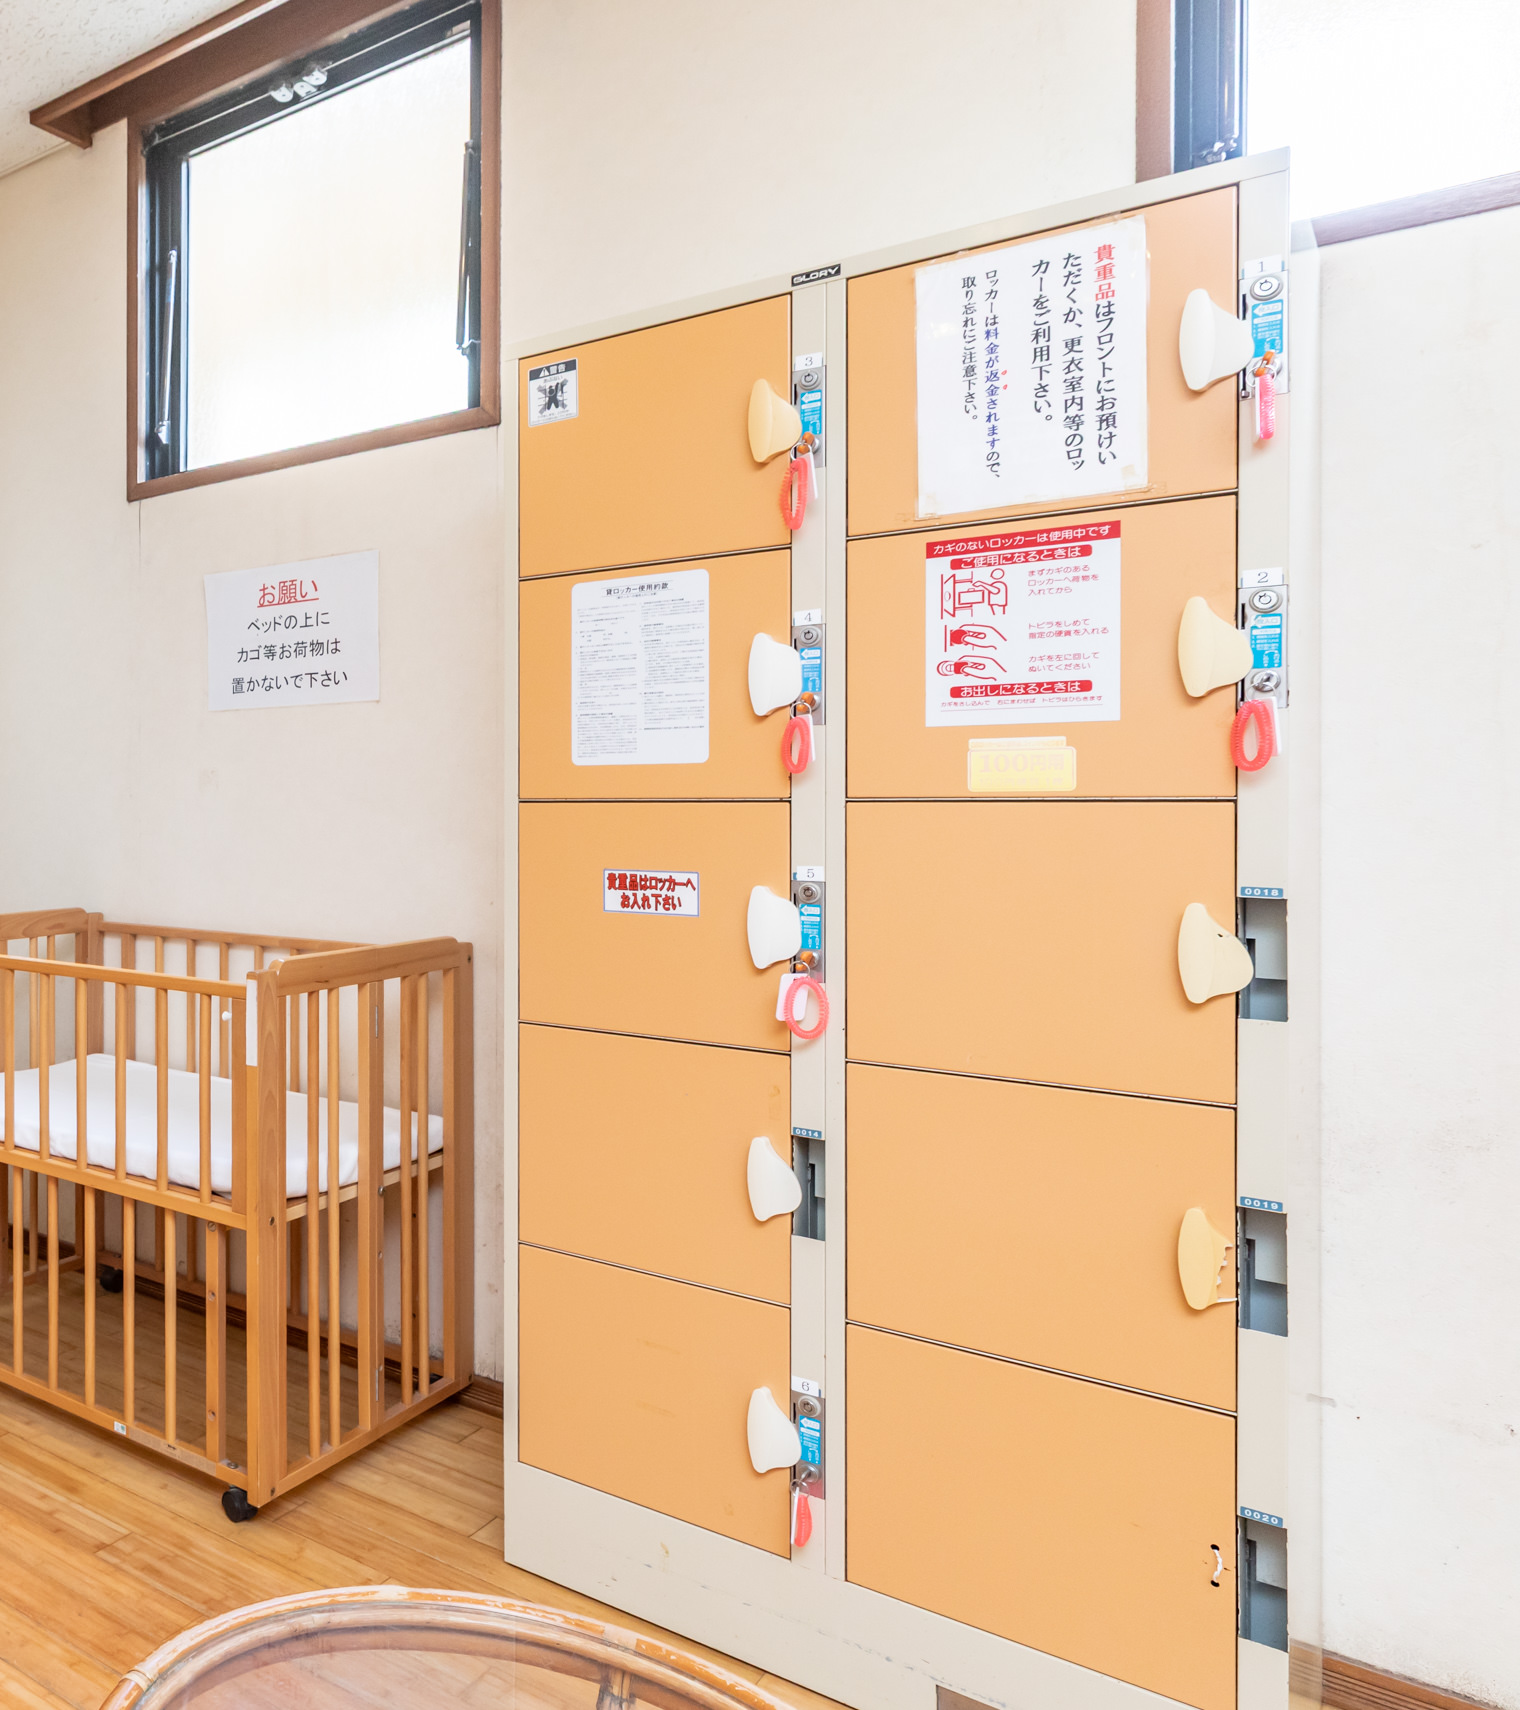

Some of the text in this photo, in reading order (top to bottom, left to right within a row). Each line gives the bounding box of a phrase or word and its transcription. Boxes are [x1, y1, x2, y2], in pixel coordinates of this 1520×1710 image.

[792, 266, 839, 284] GLORY
[1260, 261, 1264, 272] 1
[961, 276, 978, 421] 取り忘れにご注意下さい。
[1030, 259, 1053, 422] カーをご利用下さい。
[805, 356, 813, 367] 3
[1061, 252, 1085, 472] ただくか、更衣室内等のロッ
[1093, 243, 1117, 466] 貴重品はフロントにお預けい
[984, 269, 1001, 478] ロッカーは料金が返金されますので、
[933, 524, 1112, 555] カギのないロッカーは使用中です
[960, 545, 1081, 569] ご使用になるときは
[1027, 564, 1091, 577] まずカギのある
[1257, 571, 1268, 584] 2
[1027, 574, 1100, 588] ロッカーへ荷物を
[257, 578, 319, 607] お願い
[1027, 585, 1073, 597] 入れてから
[247, 611, 330, 634] ベッドの上に
[804, 612, 812, 622] 4
[1028, 618, 1091, 630] トビラをしめて
[1028, 626, 1110, 640] 指定の硬貨を入れる
[237, 637, 341, 663] カゴ等お荷物は
[1028, 651, 1100, 664] カギを左に回して
[1028, 662, 1091, 673] ぬいてください
[232, 669, 348, 694] 置かないで下さい
[960, 680, 1081, 698] お出しになるときは
[979, 753, 1065, 773] 100円用
[607, 872, 696, 892] 貴重品はロッカーへ
[807, 868, 815, 879] 5
[1244, 887, 1279, 897] 0018
[620, 891, 682, 911] お入れ下さい
[795, 1127, 819, 1138] 0014
[1244, 1198, 1279, 1210] 0019
[801, 1381, 809, 1392] 6
[1244, 1508, 1279, 1525] 0020
